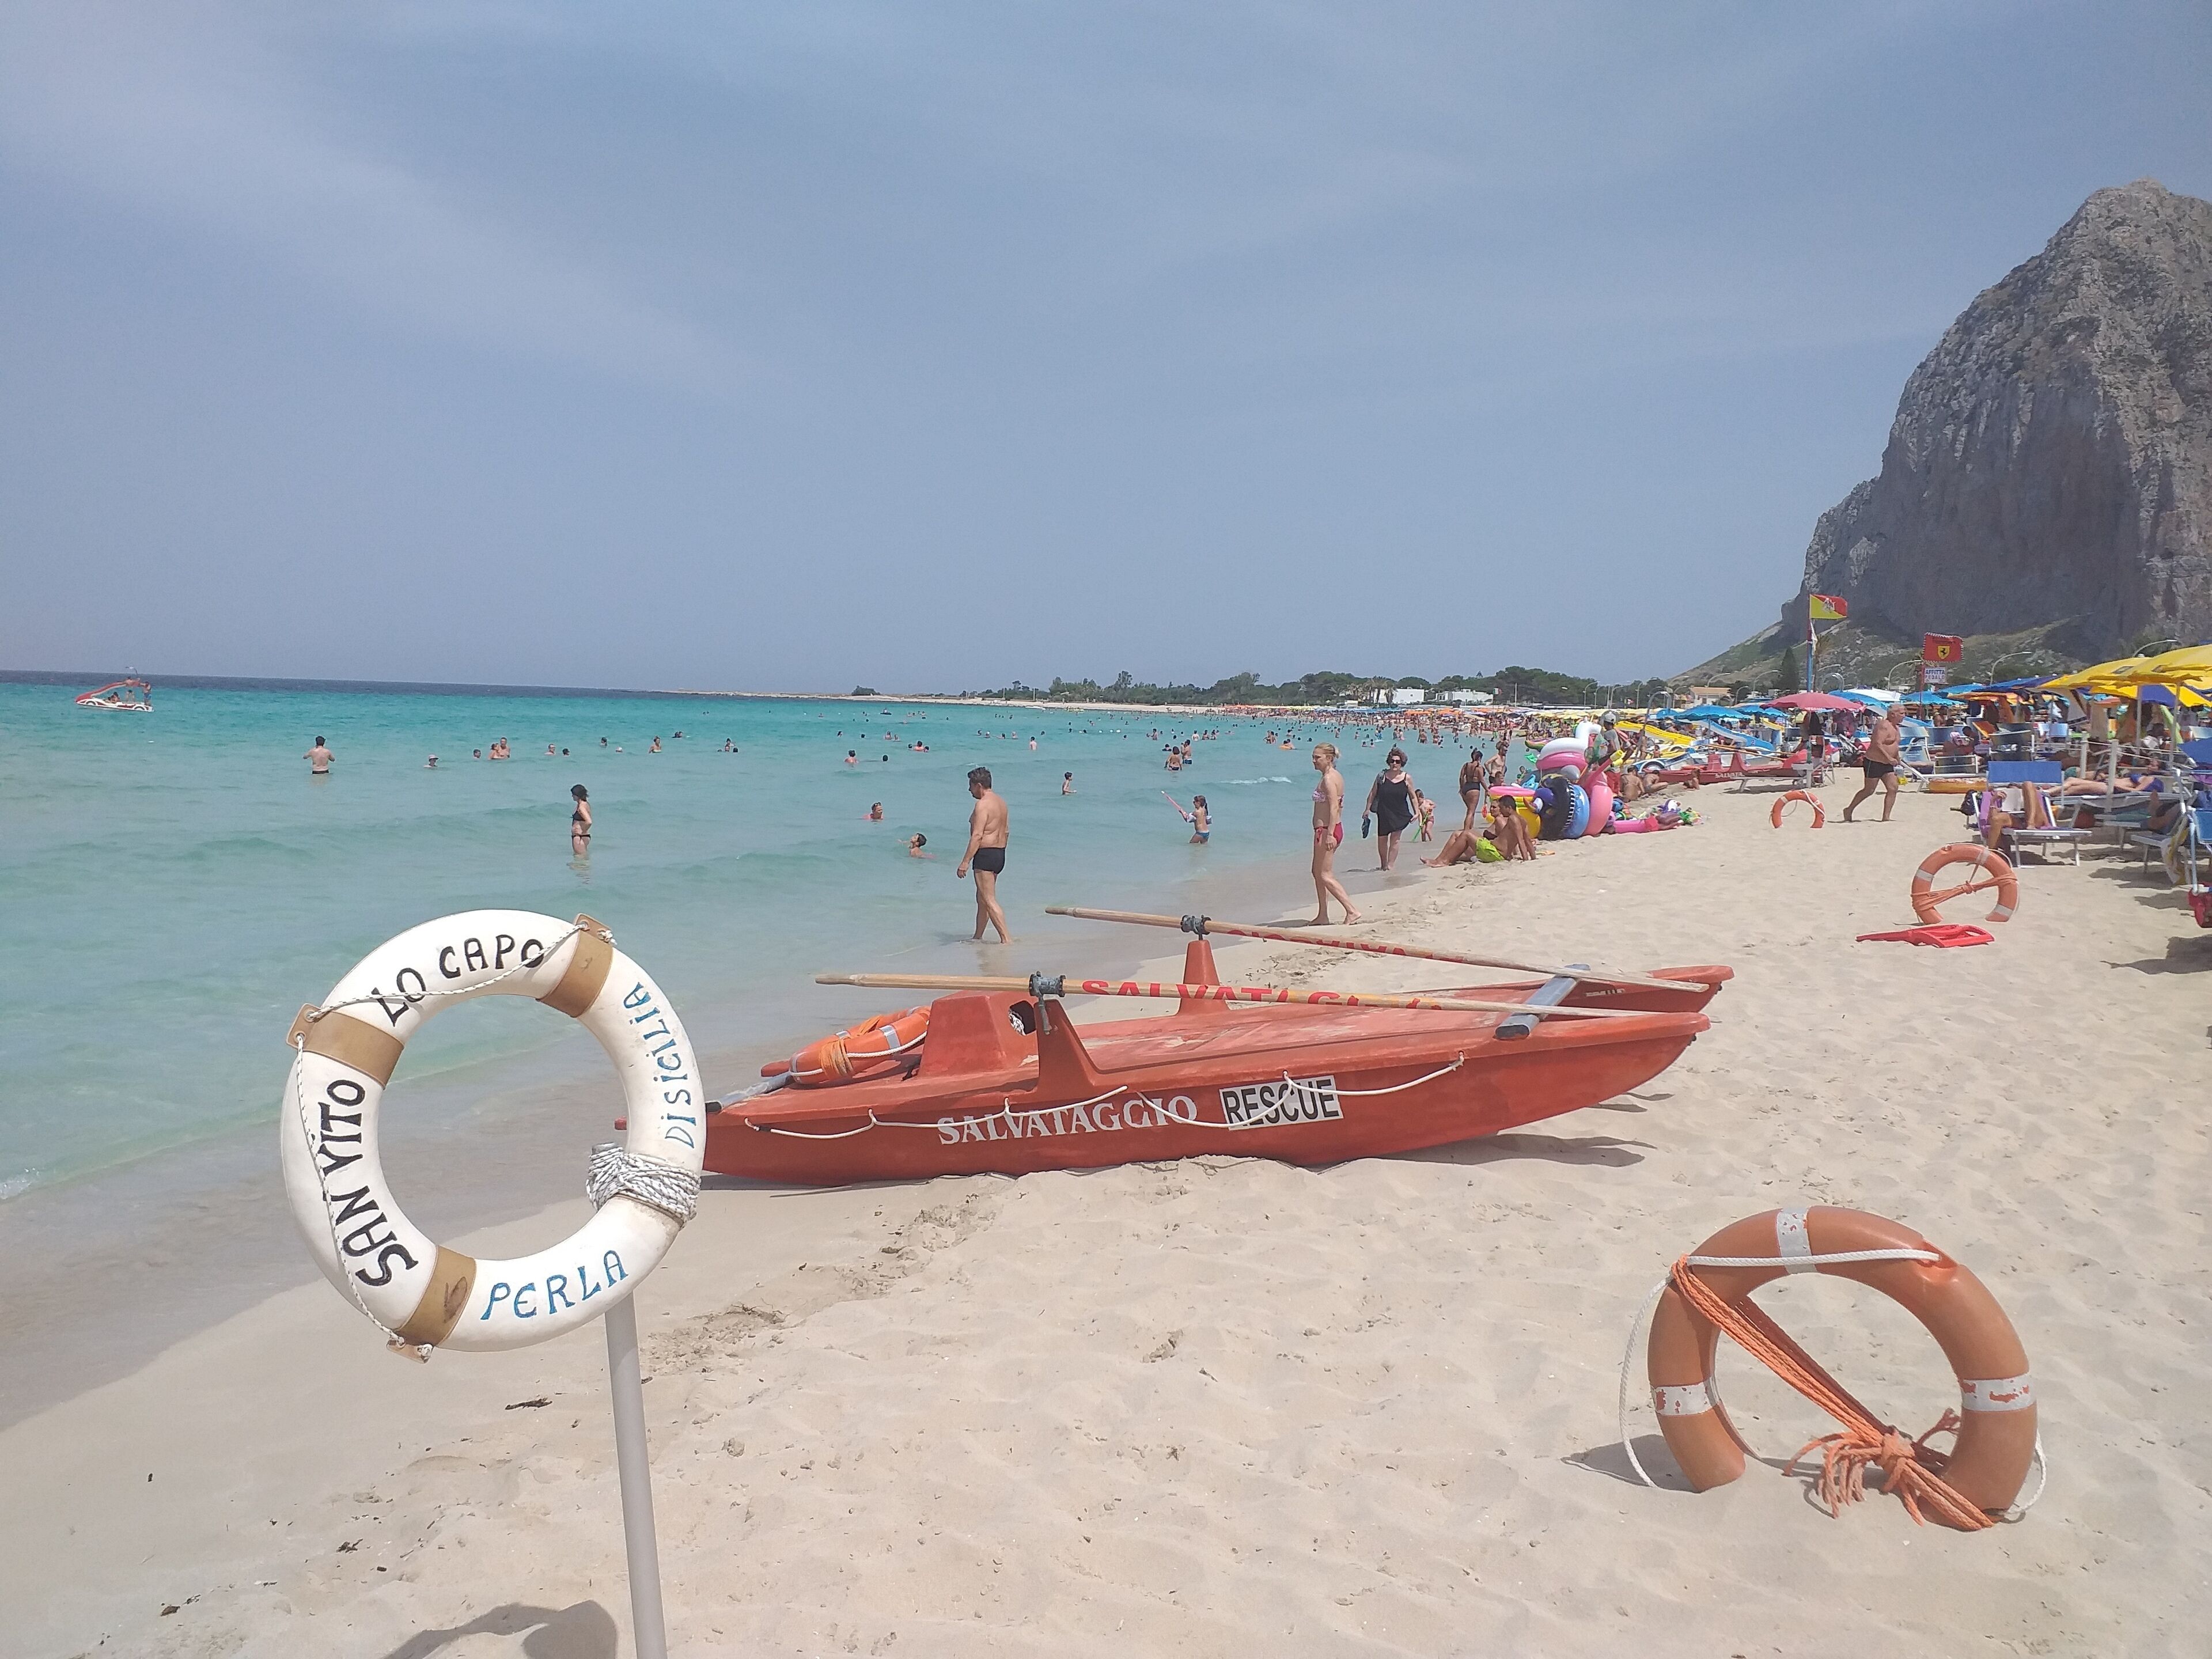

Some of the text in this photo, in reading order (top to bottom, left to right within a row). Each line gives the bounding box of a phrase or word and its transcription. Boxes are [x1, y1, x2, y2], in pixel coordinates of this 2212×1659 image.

[372, 934, 544, 1027] LO CAPO
[937, 1079, 1339, 1145] SALVATAGGIO RESCUE
[323, 1184, 419, 1287] SAN
[480, 1249, 629, 1320] PERLA
